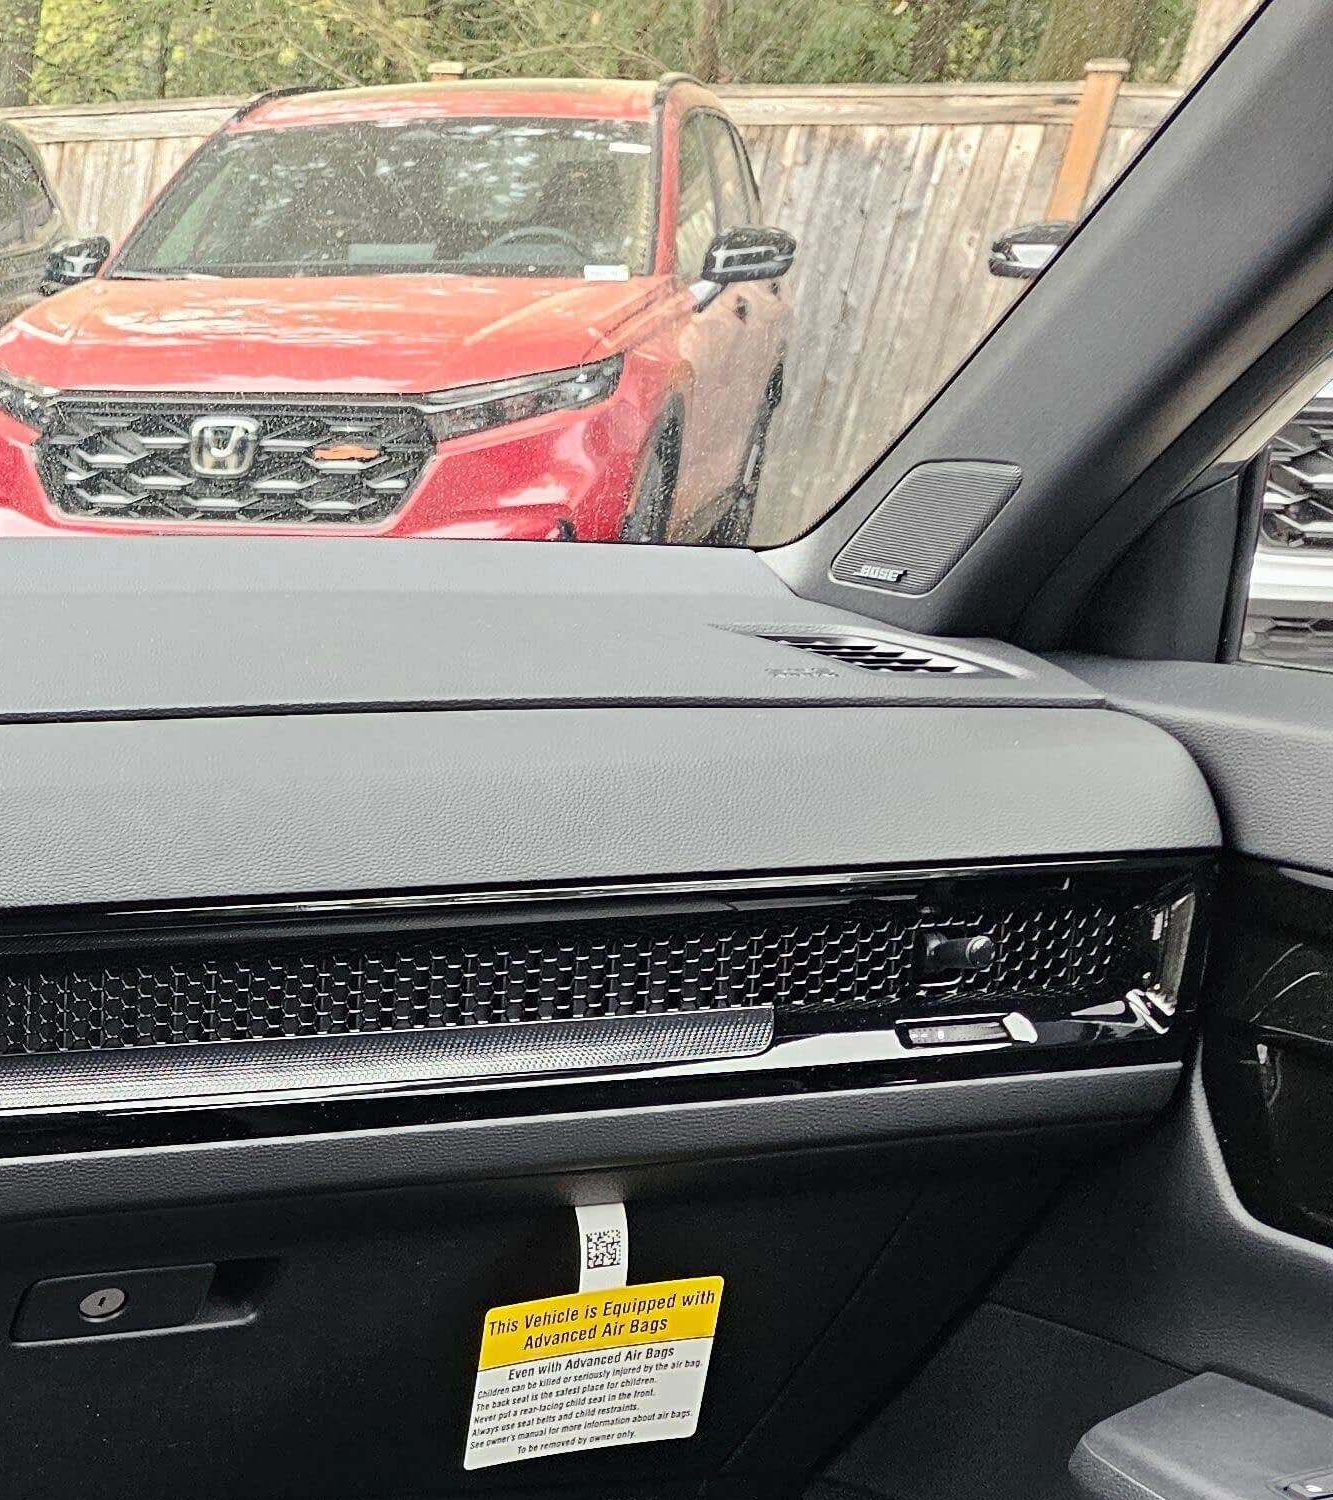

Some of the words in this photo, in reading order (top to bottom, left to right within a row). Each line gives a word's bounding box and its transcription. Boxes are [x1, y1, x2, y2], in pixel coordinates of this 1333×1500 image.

[854, 564, 905, 582] BOSE
[489, 1318, 519, 1337] This
[525, 1307, 579, 1329] Vehicle
[584, 1304, 598, 1319] is
[603, 1292, 677, 1318] Equipped
[682, 1289, 715, 1307] with
[523, 1324, 598, 1350] Advanced
[601, 1321, 625, 1338] Air
[629, 1318, 668, 1335] Bags
[477, 1386, 510, 1400] Children
[511, 1383, 526, 1393] can
[527, 1381, 537, 1390] be
[539, 1375, 562, 1387] killed
[563, 1374, 572, 1384] or
[572, 1367, 611, 1382] seriously
[612, 1364, 641, 1377] injured
[643, 1363, 654, 1372] by
[655, 1361, 669, 1371] the
[670, 1360, 683, 1369] air
[684, 1359, 703, 1369] bag.
[508, 1366, 535, 1381] Even
[538, 1361, 562, 1375] with
[565, 1351, 621, 1371] Advanced
[624, 1349, 643, 1362] Air
[645, 1346, 675, 1360] Bags
[473, 1414, 497, 1425] Never
[498, 1410, 512, 1420] put
[519, 1402, 564, 1416] rear-facing
[565, 1397, 586, 1408] child
[587, 1394, 606, 1405] seat
[607, 1392, 616, 1402] in
[618, 1391, 632, 1400] the
[633, 1388, 656, 1399] front.
[476, 1402, 490, 1412] The
[491, 1399, 510, 1409] back
[512, 1394, 530, 1405] seat
[530, 1393, 539, 1401] is
[540, 1391, 553, 1400] the
[555, 1386, 581, 1398] safest
[581, 1382, 605, 1394] place
[606, 1380, 619, 1390] for
[620, 1376, 657, 1388] children.
[469, 1440, 485, 1450] See
[486, 1434, 516, 1446] owner's
[517, 1428, 547, 1440] manual
[548, 1427, 560, 1435] for
[561, 1422, 582, 1432] more
[583, 1416, 631, 1430] information
[631, 1413, 656, 1423] about
[657, 1411, 670, 1420] air
[670, 1409, 693, 1419] bags.
[471, 1425, 500, 1437] Always
[501, 1422, 515, 1431] use
[517, 1418, 535, 1429] seat
[536, 1414, 556, 1425] belts
[557, 1411, 573, 1421] and
[575, 1409, 596, 1419] child
[597, 1403, 640, 1415] restraints.
[517, 1445, 526, 1455] To
[528, 1444, 538, 1453] be
[540, 1437, 576, 1450] removed
[578, 1436, 588, 1445] by
[589, 1433, 615, 1443] owner
[616, 1429, 636, 1439] only.
